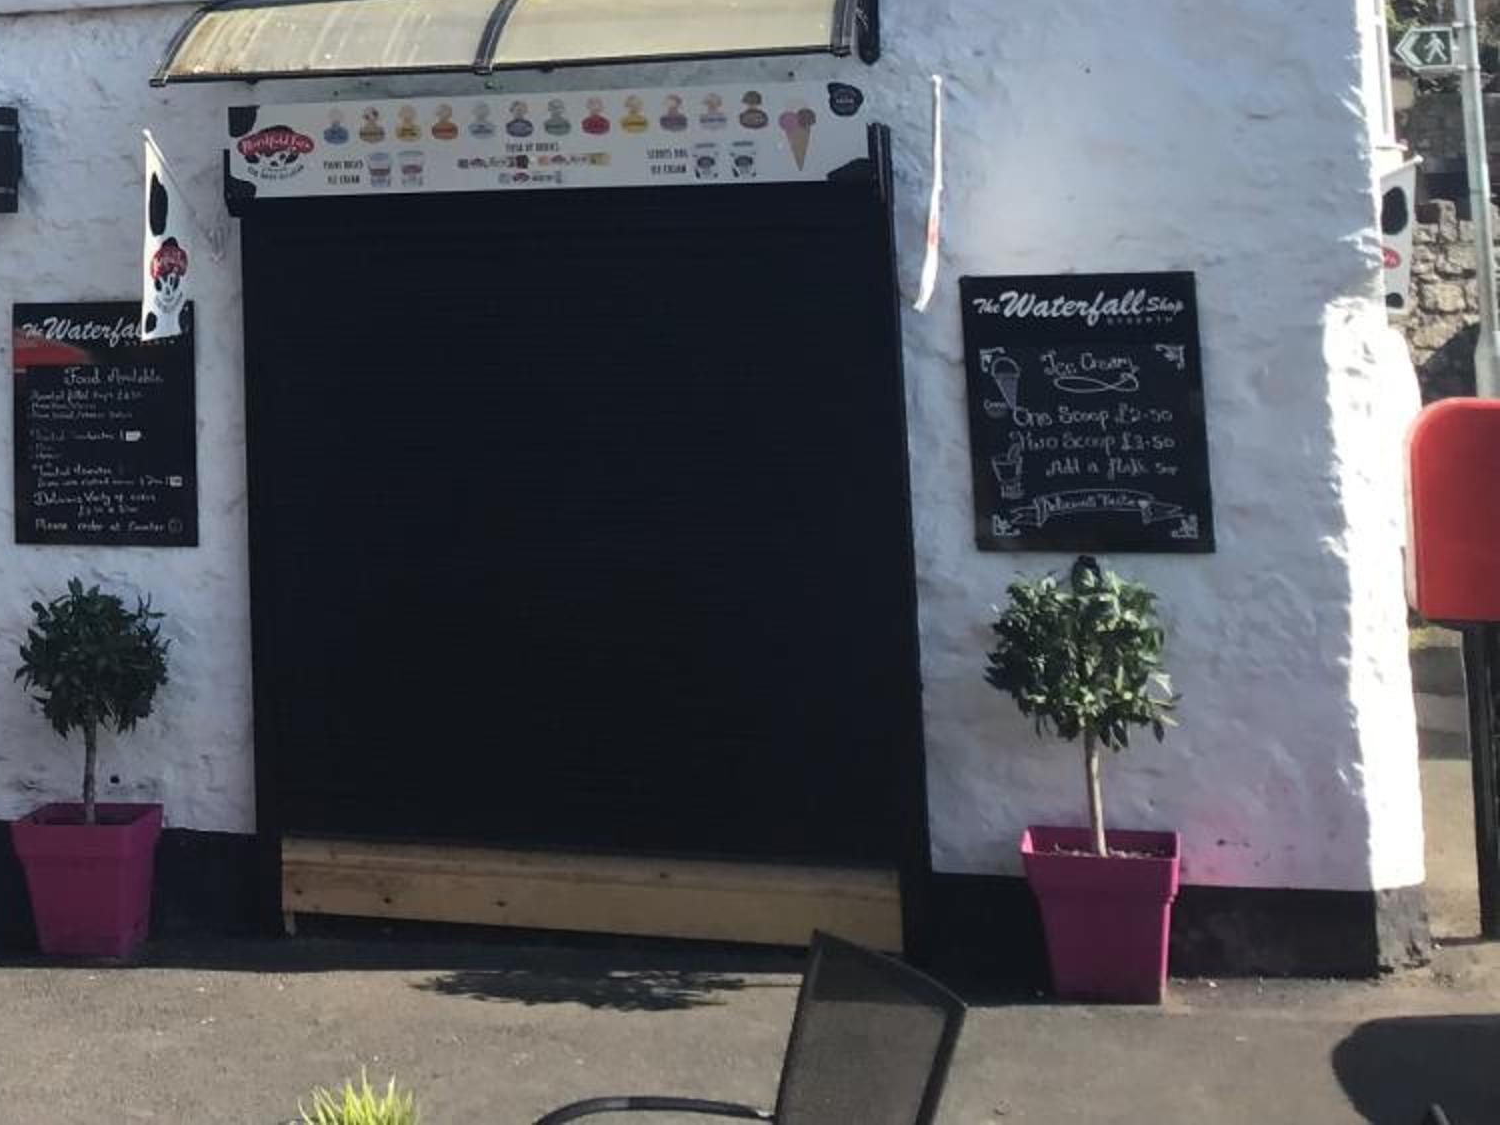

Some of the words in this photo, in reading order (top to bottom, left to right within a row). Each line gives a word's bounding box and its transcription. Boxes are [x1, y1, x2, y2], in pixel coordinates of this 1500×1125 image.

[973, 298, 1000, 315] The
[999, 288, 1146, 327] Waterfall
[1145, 296, 1184, 315] Shop
[1013, 406, 1053, 427] One
[1058, 406, 1109, 431] Scoop
[1009, 431, 1057, 452] Two
[1062, 432, 1115, 456] Scoop
